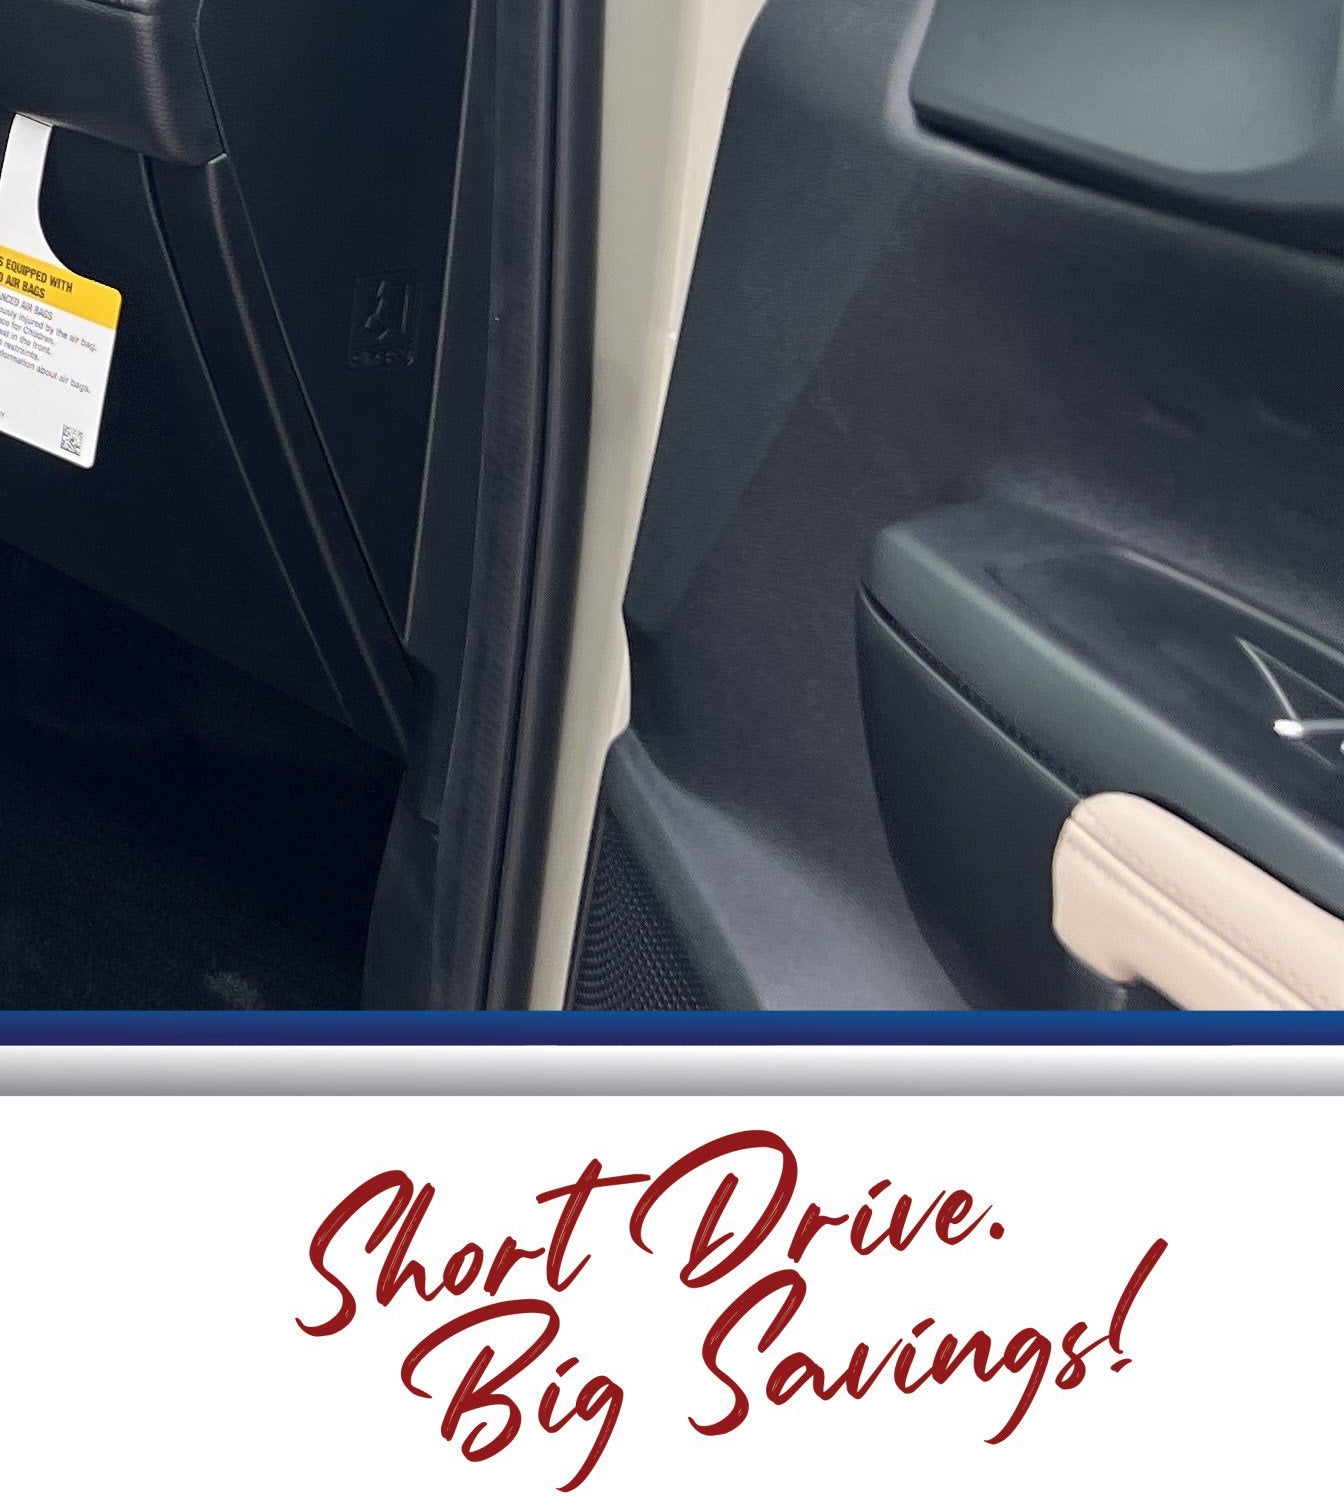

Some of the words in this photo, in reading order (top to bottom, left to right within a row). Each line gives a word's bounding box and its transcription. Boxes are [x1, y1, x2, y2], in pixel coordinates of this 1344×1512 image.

[4, 273, 20, 289] AIR
[21, 280, 45, 299] BAGS
[5, 257, 47, 284] EQUIPPED
[48, 274, 73, 294] WITH
[20, 299, 32, 312] AIR
[33, 304, 53, 321] BAGS
[11, 320, 21, 331] for
[18, 312, 43, 331] injured
[55, 327, 68, 339] the
[69, 332, 79, 344] air
[19, 334, 31, 347] the
[36, 364, 57, 380] about
[58, 373, 68, 385] air
